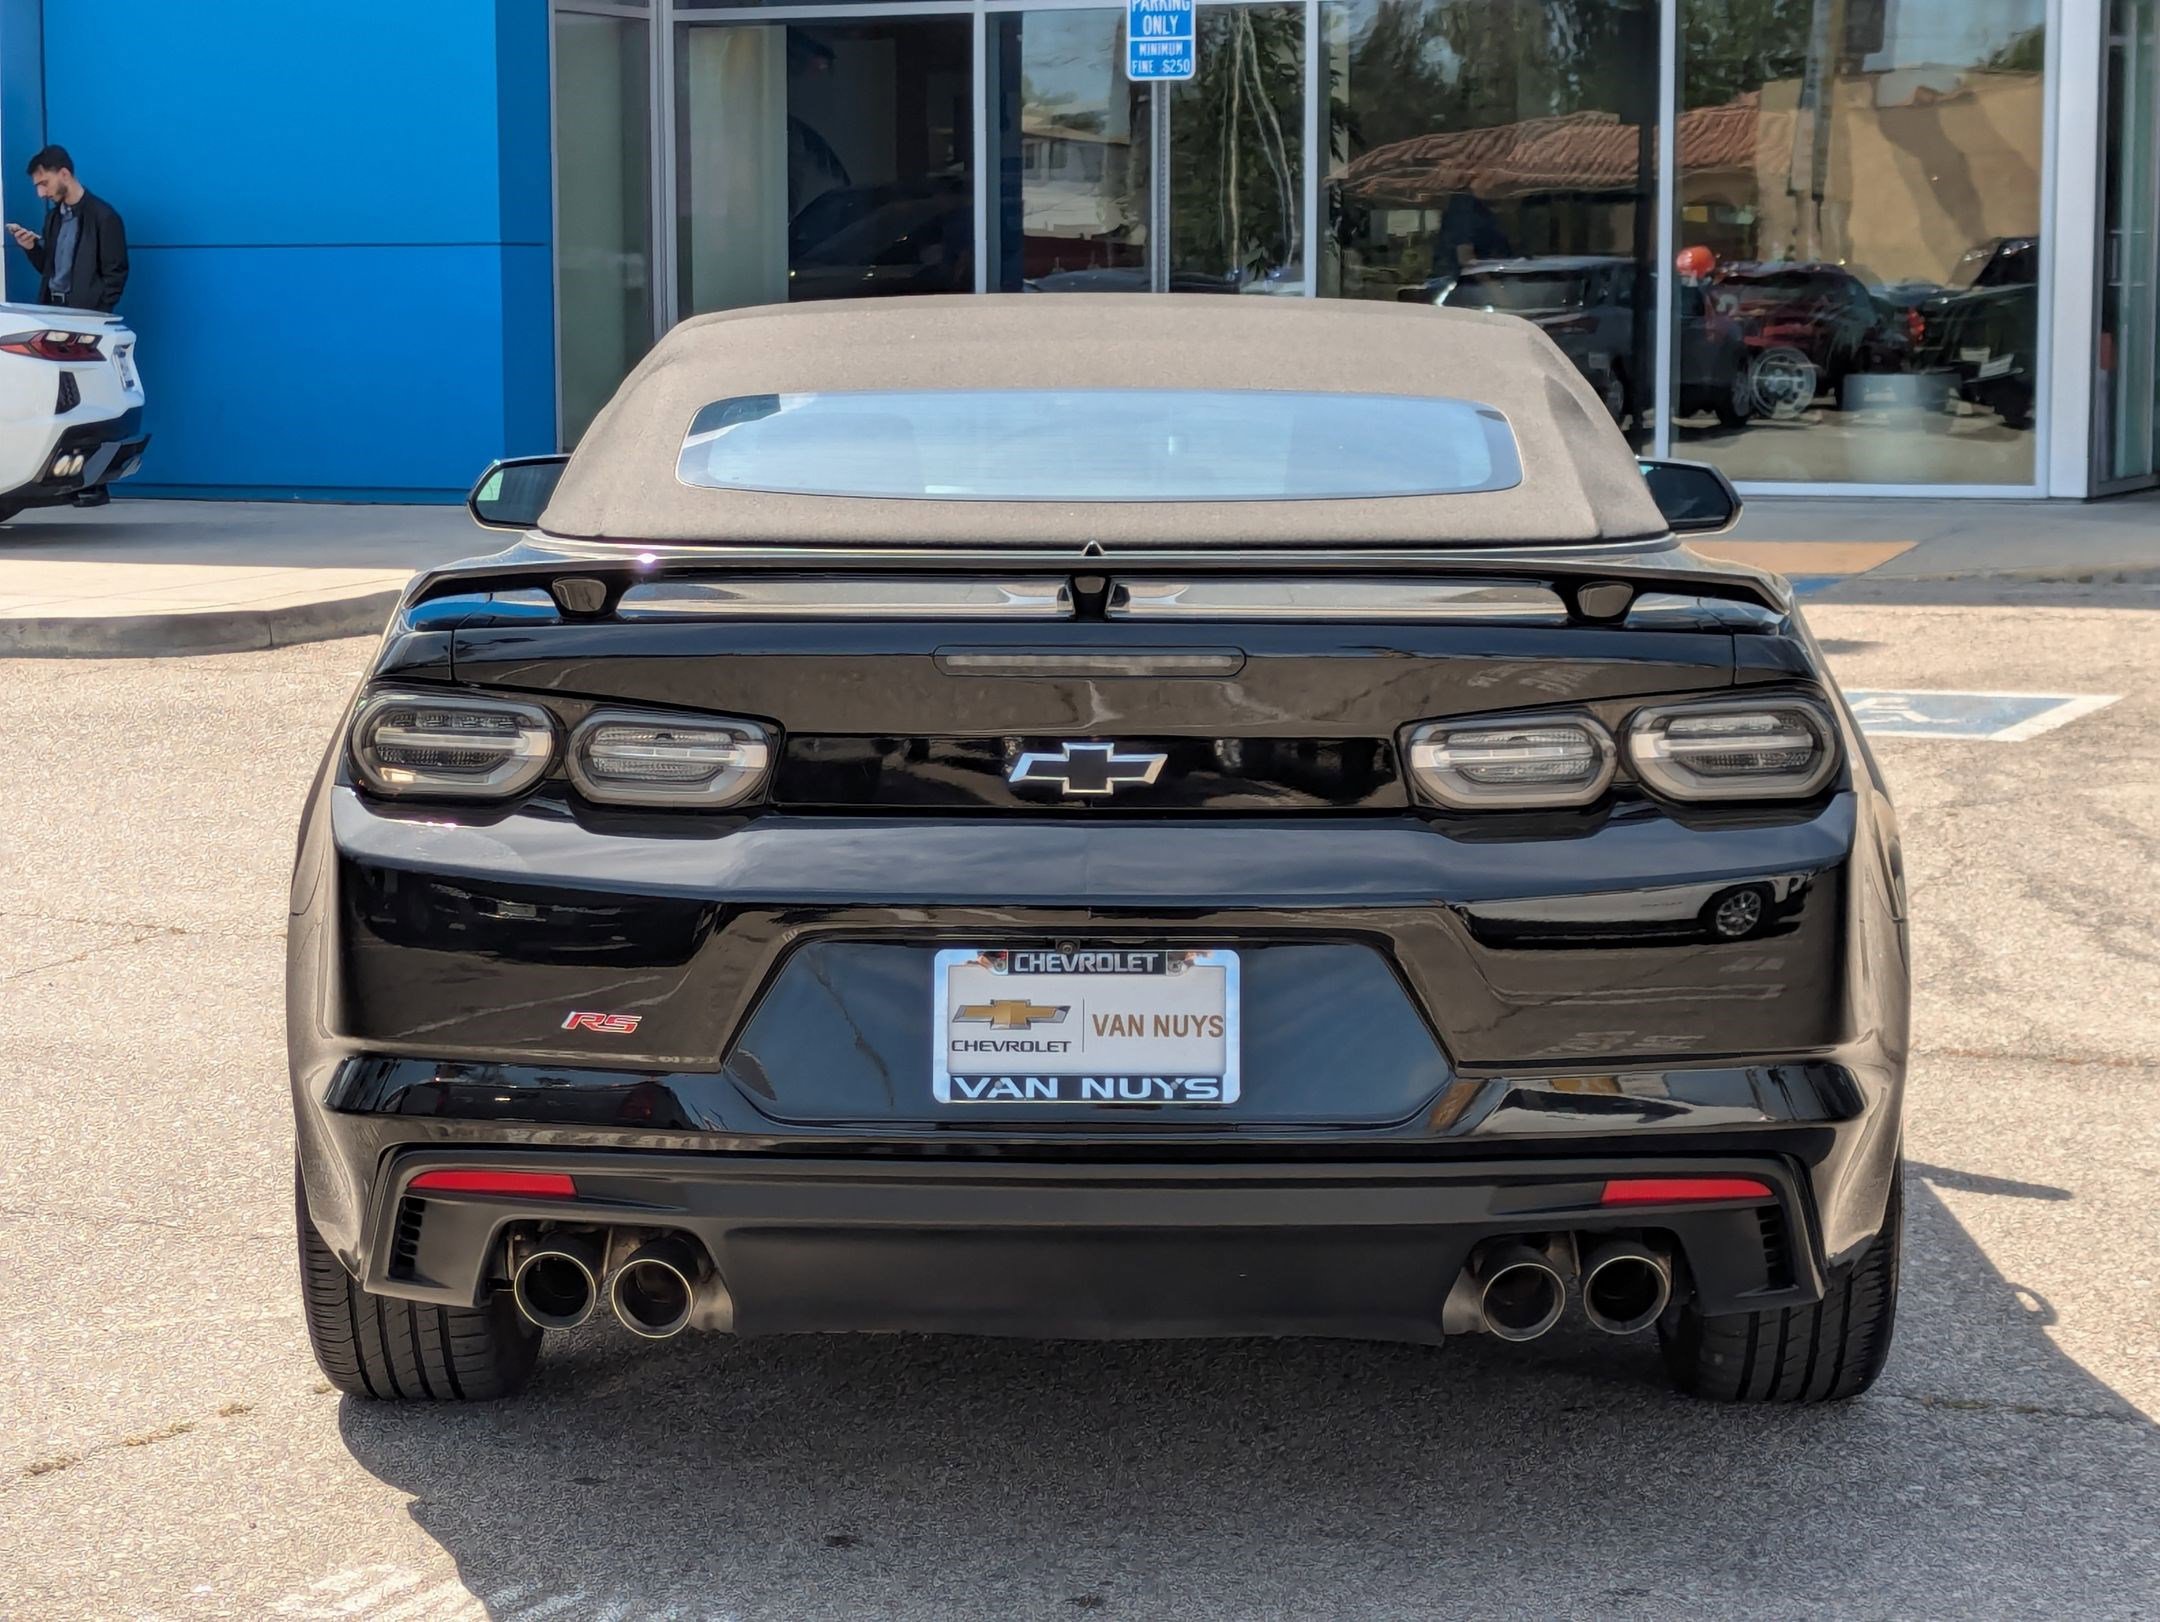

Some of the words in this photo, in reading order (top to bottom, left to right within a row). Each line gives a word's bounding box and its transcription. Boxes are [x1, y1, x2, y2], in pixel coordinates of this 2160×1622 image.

[1132, 0, 1190, 12] PARKING
[1143, 15, 1179, 35] ONLY
[1139, 42, 1183, 56] MINIMUM
[1132, 60, 1154, 74] FINE
[1162, 59, 1191, 74] $250
[1014, 952, 1159, 973] CHEVROLET
[561, 1011, 642, 1034] RS
[1091, 1014, 1144, 1037] VAN
[1153, 1014, 1224, 1038] NUYS
[951, 1039, 1072, 1053] CHEVROLET
[953, 1077, 1058, 1099] VAN
[1081, 1078, 1220, 1100] NUYS
